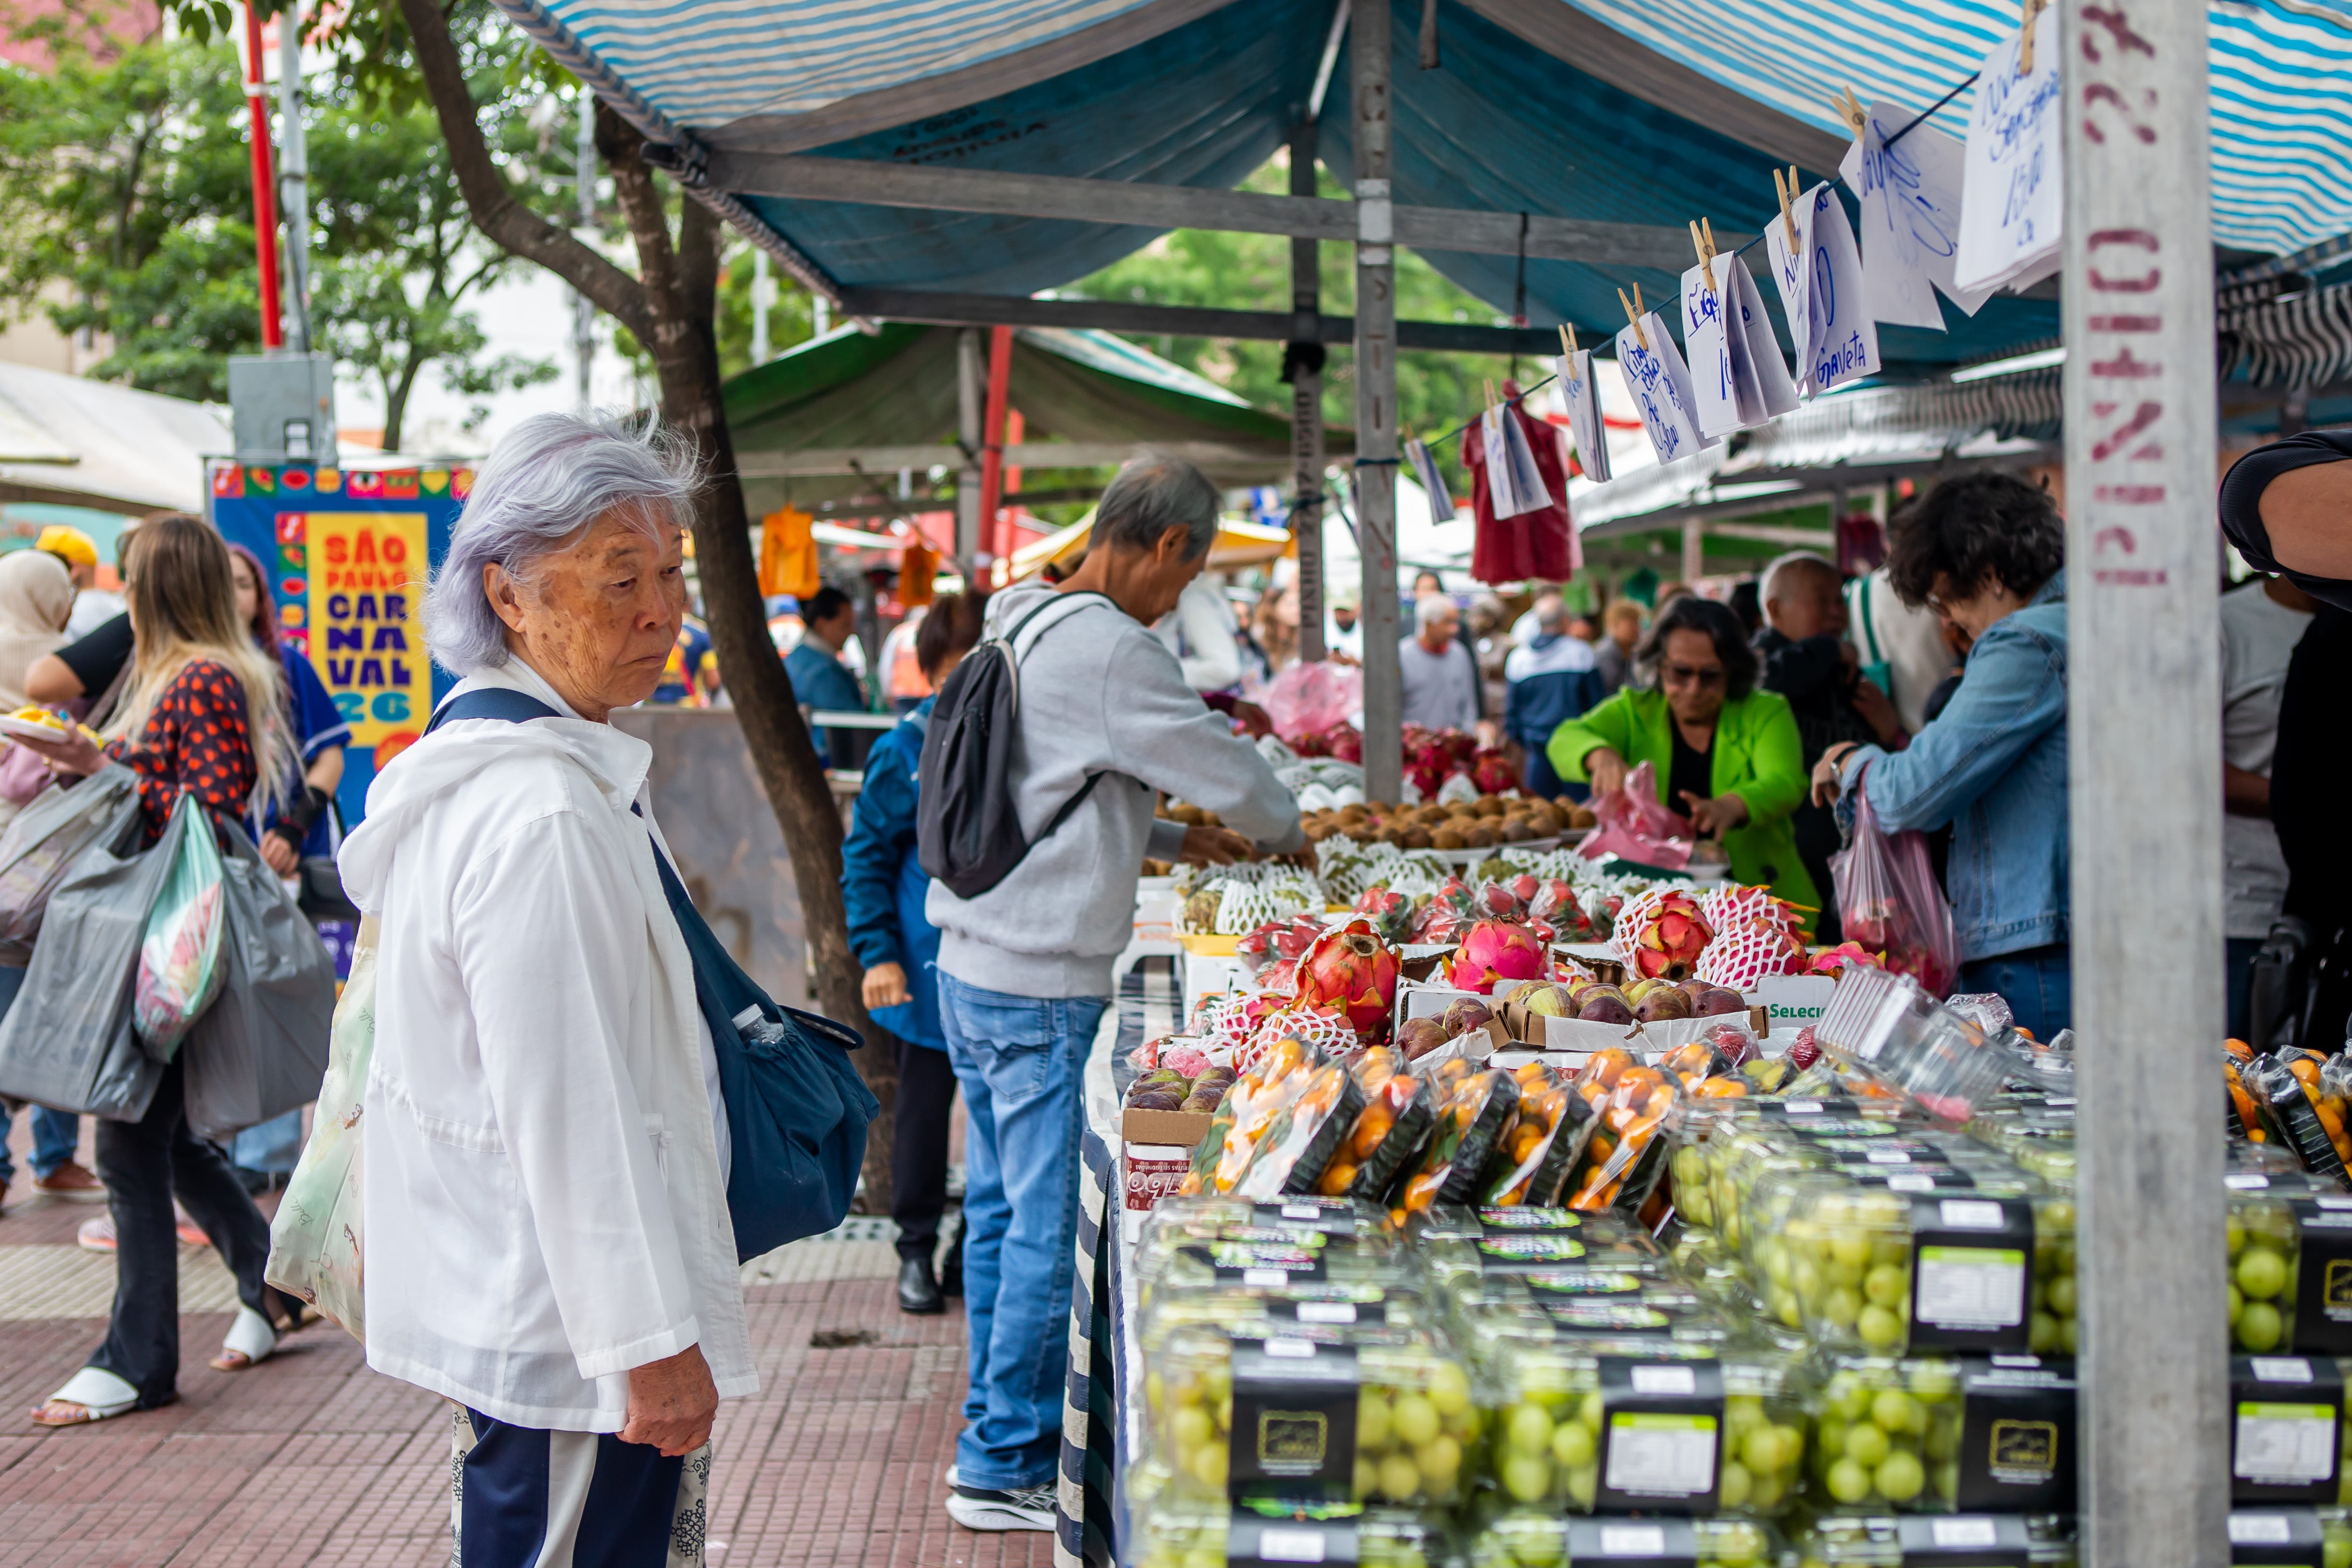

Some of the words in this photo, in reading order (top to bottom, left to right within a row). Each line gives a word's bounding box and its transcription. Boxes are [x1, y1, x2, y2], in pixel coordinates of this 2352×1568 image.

[326, 570, 407, 590] PAULO
[327, 594, 407, 620] CAR
[327, 627, 407, 651] NA
[327, 659, 411, 687] VAL
[332, 693, 411, 722] 26
